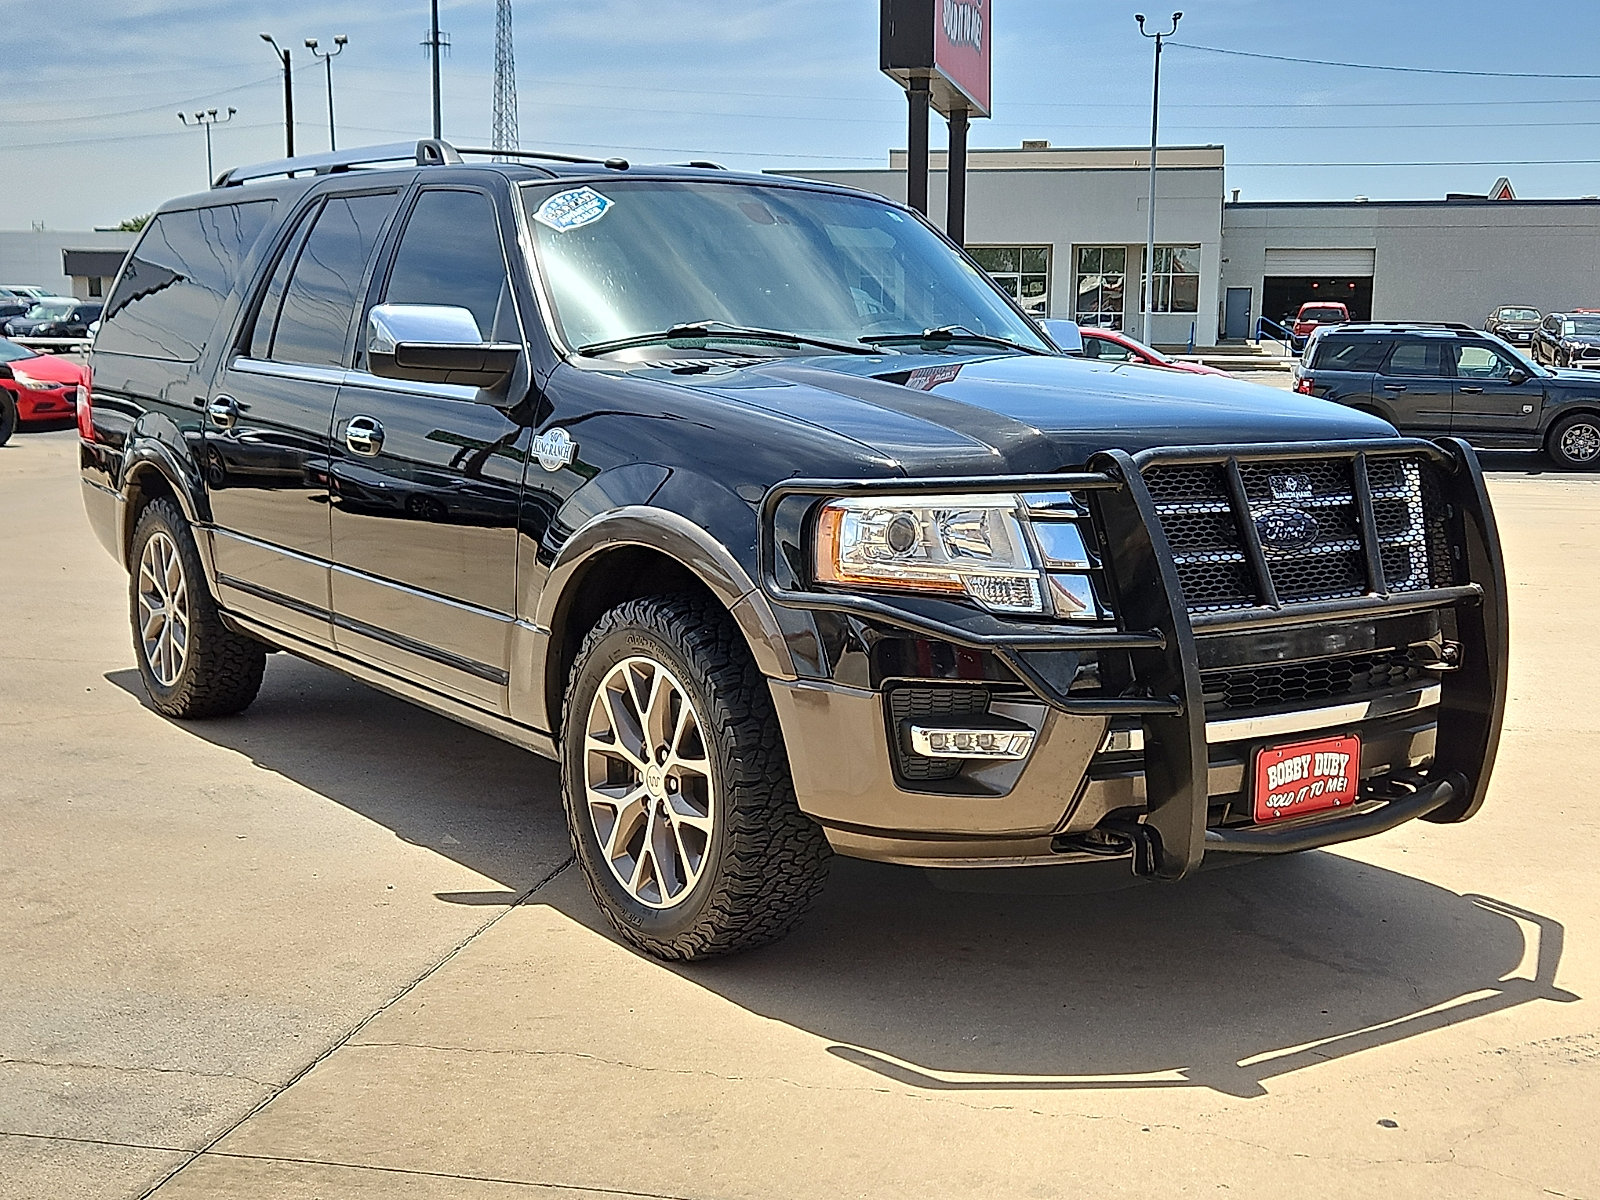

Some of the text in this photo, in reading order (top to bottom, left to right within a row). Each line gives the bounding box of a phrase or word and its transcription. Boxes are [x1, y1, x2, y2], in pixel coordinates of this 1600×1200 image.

[533, 439, 572, 460] KING RANCH
[1267, 752, 1350, 791] BOBBY DUBY
[1266, 777, 1349, 808] SOLD IT TO ME!
